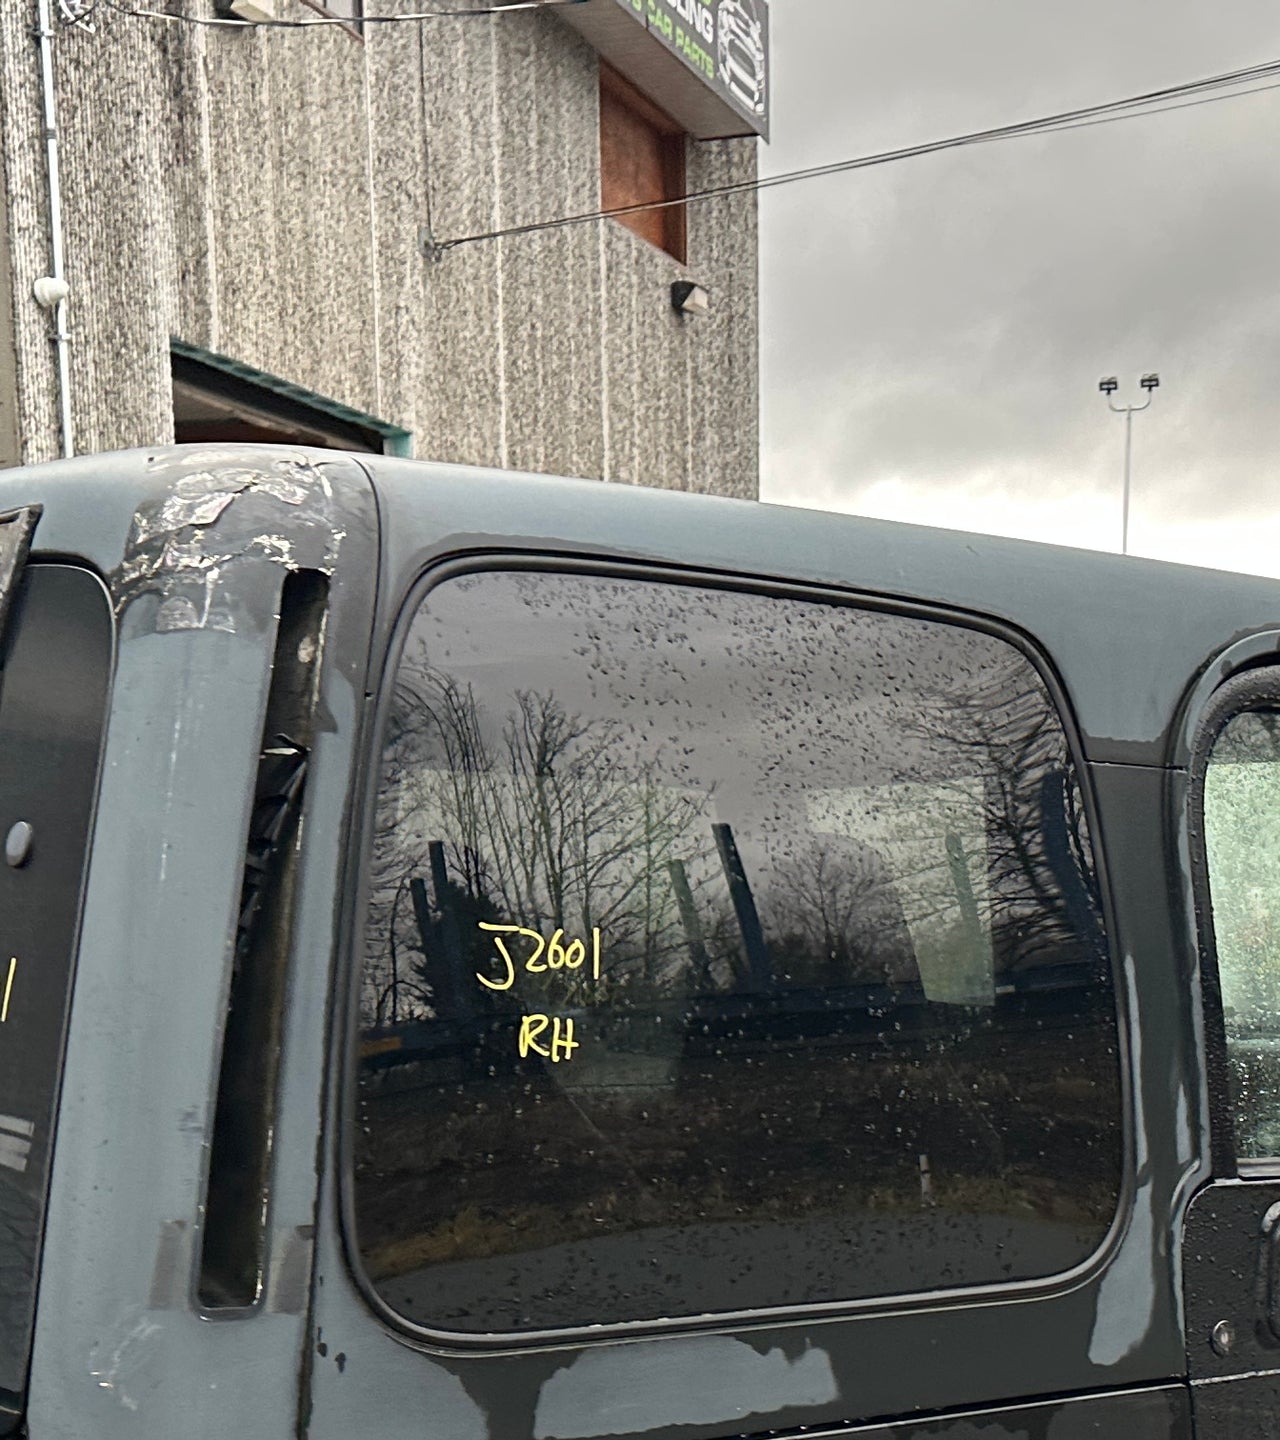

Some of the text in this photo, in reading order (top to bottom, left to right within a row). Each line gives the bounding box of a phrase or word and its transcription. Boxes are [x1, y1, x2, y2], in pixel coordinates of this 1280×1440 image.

[665, 0, 714, 44] LING
[675, 26, 715, 79] PARTS
[476, 922, 601, 990] J2601
[519, 1014, 579, 1062] RH
